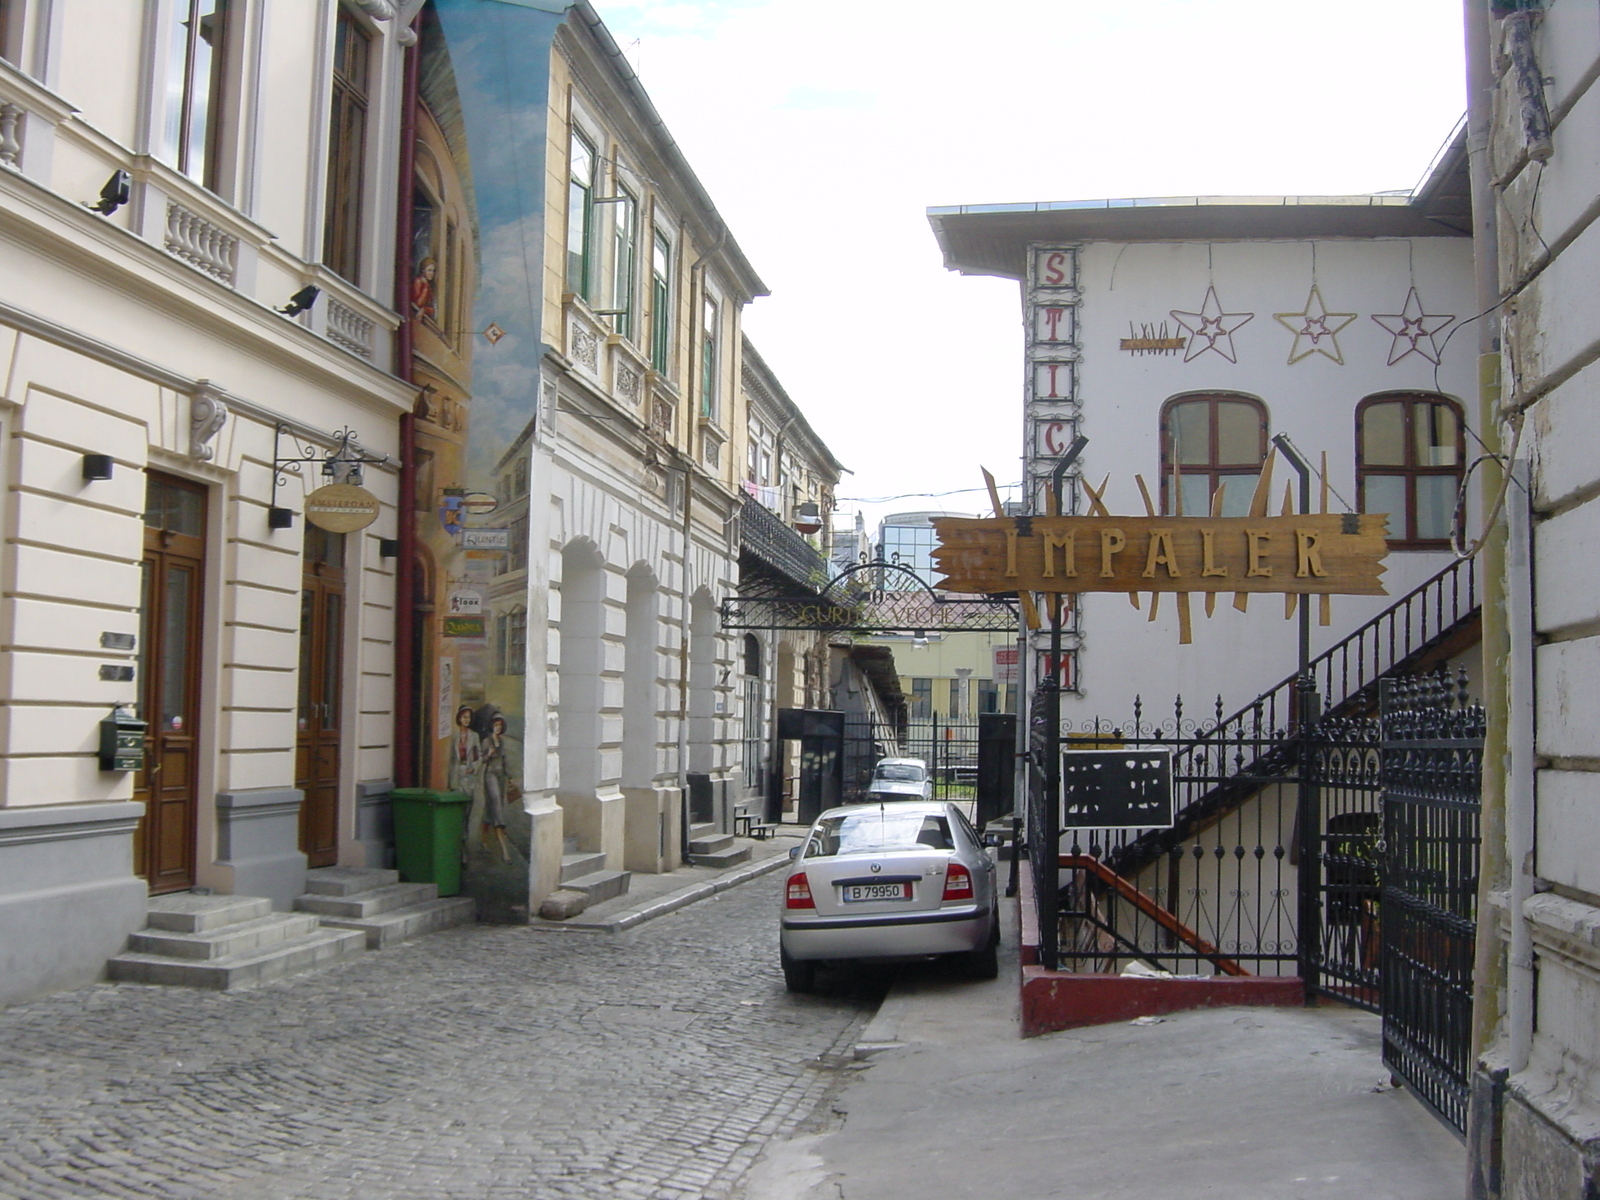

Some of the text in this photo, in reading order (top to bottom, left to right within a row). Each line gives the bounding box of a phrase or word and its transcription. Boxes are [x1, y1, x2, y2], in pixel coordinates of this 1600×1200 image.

[310, 499, 375, 508] AMSTERDAM
[1005, 528, 1328, 578] IMPALER
[802, 605, 954, 624] CURTEA VECHE
[853, 885, 900, 899] B 79950
